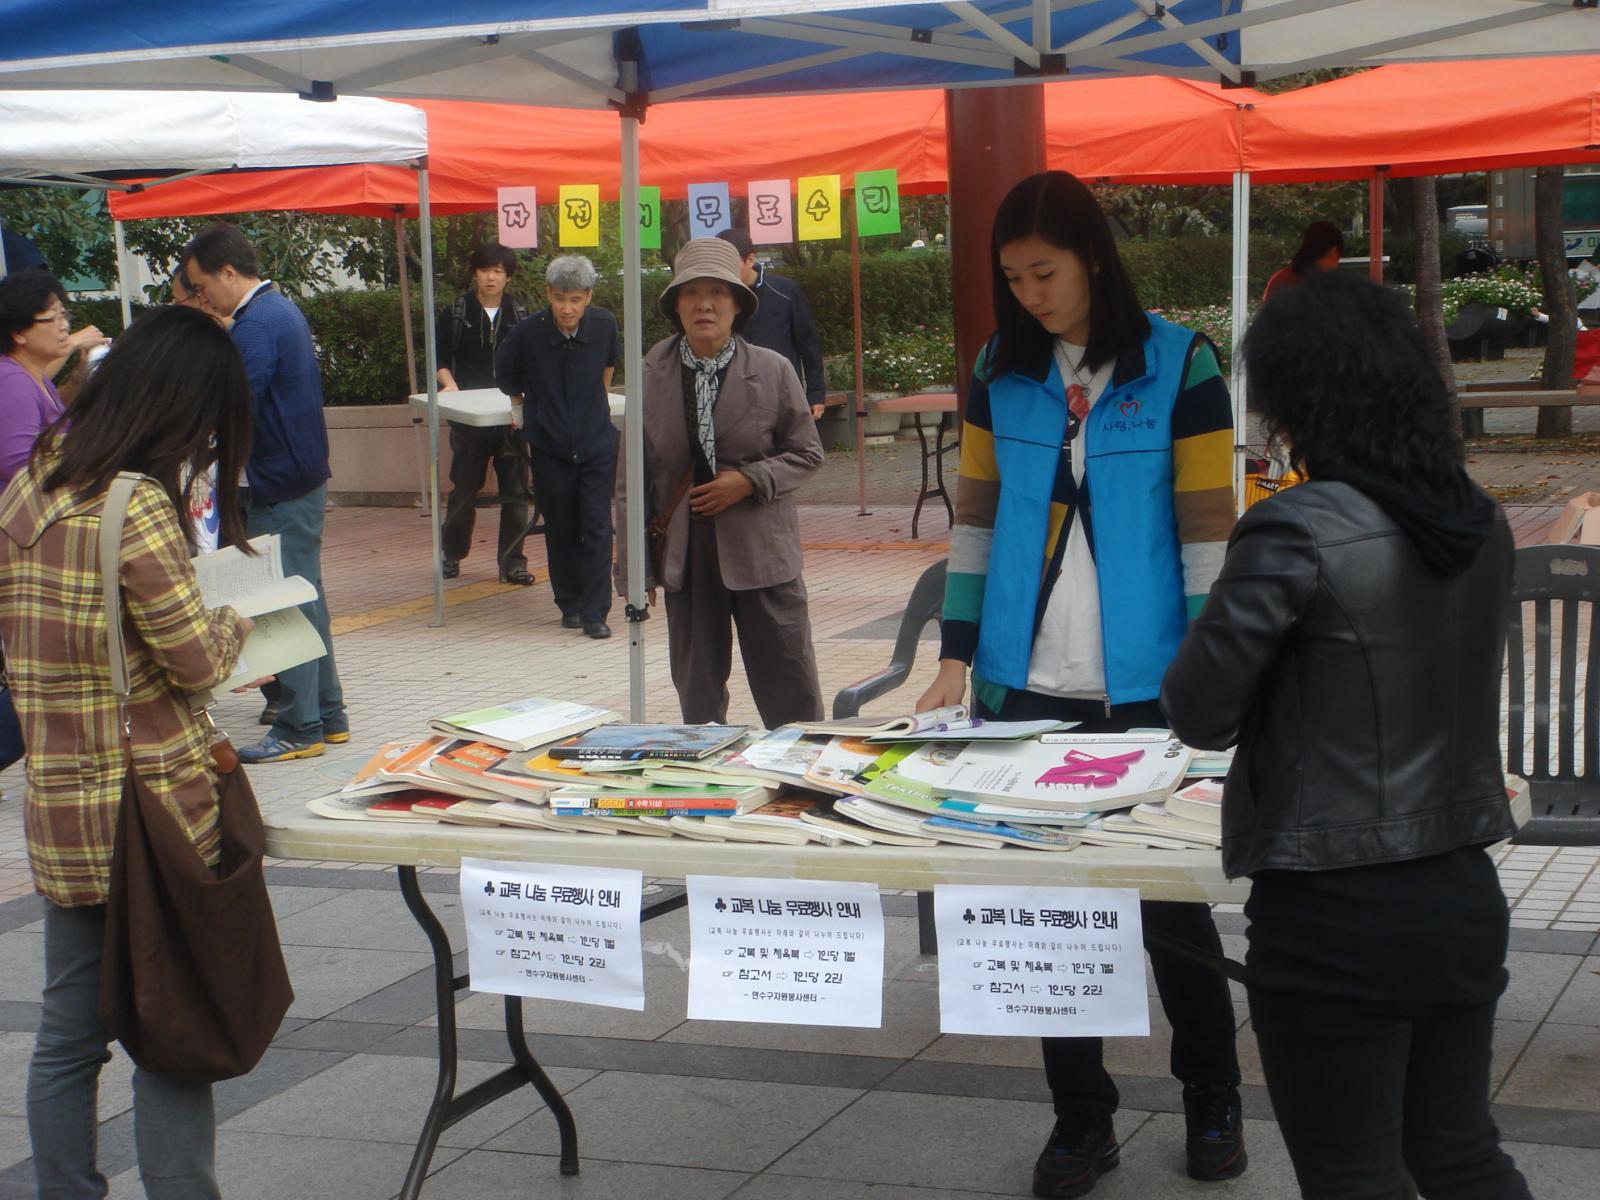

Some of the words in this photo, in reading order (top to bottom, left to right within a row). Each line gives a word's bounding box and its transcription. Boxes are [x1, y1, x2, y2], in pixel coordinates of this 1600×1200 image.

[499, 881, 521, 899] 교복
[525, 883, 547, 901] 나눔
[550, 886, 594, 905] 무료행사
[598, 889, 621, 908] 안내
[731, 898, 755, 914] 교복
[758, 899, 782, 915] 나눔
[786, 900, 833, 918] 무료행사
[836, 902, 861, 919] 안내
[980, 908, 1005, 925] 교복
[1010, 909, 1035, 927] 나눔
[1039, 909, 1088, 929] 무료행사
[1092, 910, 1118, 929] 안내
[507, 929, 523, 940] 교복
[527, 931, 536, 941] 및
[540, 932, 564, 944] 체육복
[580, 936, 600, 948] 1인당
[604, 938, 615, 950] 1벌
[510, 949, 541, 961] 참고서
[561, 954, 585, 966] 1인당
[589, 958, 606, 969] 2권
[738, 947, 755, 958] 교복
[760, 948, 769, 959] 및
[773, 948, 800, 959] 체육복
[817, 950, 839, 962] 1인당
[844, 951, 856, 962] 1벌
[987, 960, 1006, 971] 교복
[1010, 960, 1020, 971] 및
[1025, 961, 1053, 973] 체육복
[1071, 962, 1095, 974] 1인당
[1099, 963, 1114, 974] 1벌
[525, 969, 585, 983] 연수구자원봉사센터
[738, 969, 772, 981] 참고서
[793, 971, 819, 984] 1인당
[824, 973, 843, 984] 2권
[989, 981, 1025, 995] 참고서
[1048, 984, 1076, 996] 1인당
[1082, 985, 1103, 996] 2권
[752, 991, 817, 1002] 연수구자원봉사센터
[1006, 1004, 1077, 1016] 연수구자원봉사센터
